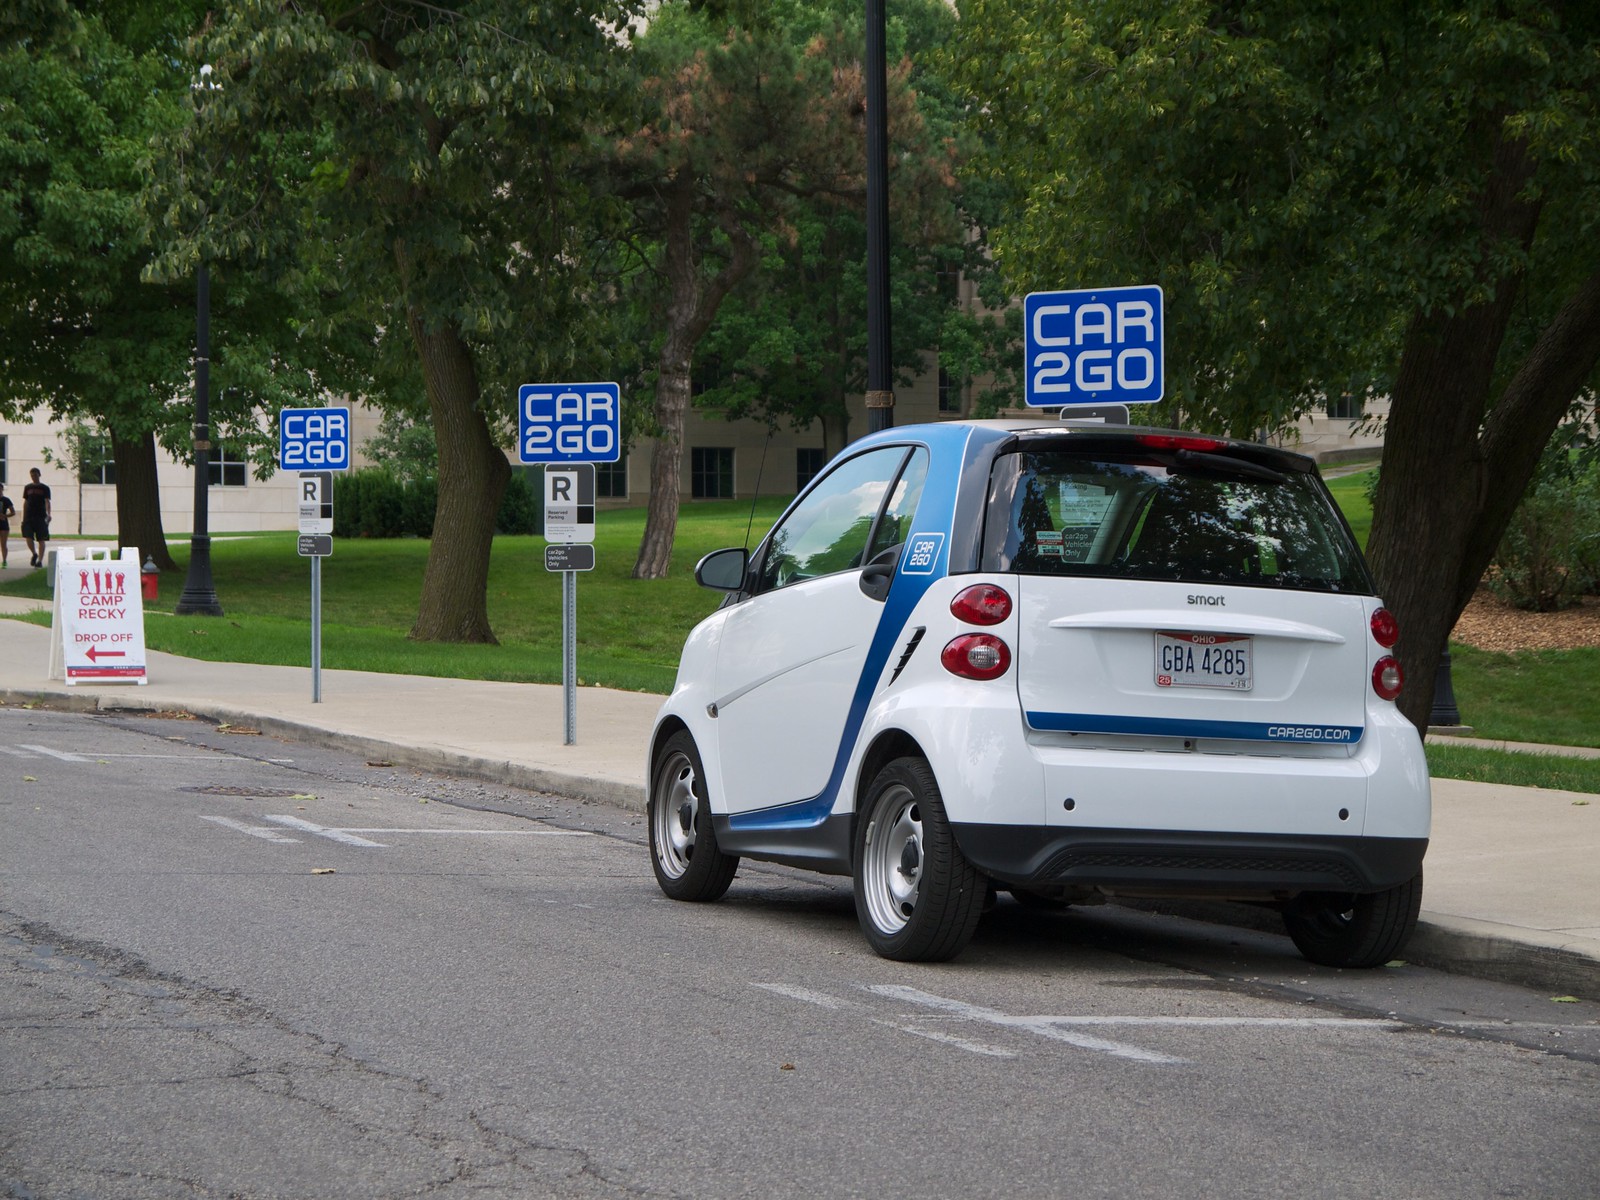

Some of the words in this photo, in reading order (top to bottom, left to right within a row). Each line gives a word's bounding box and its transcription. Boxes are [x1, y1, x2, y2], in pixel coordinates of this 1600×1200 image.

[1033, 300, 1154, 347] CAR
[1033, 348, 1154, 394] 2GO
[525, 392, 614, 422] CAR
[284, 415, 345, 439] CAR
[525, 424, 614, 454] 2GO
[284, 440, 345, 464] 2GO
[303, 481, 317, 501] R
[552, 476, 571, 501] R
[914, 542, 934, 553] CAR
[1065, 549, 1081, 558] Only
[910, 554, 930, 565] 2GO
[80, 595, 123, 606] CAMP
[1187, 594, 1226, 607] smart
[78, 608, 126, 619] RECKY
[75, 633, 107, 642] DROP
[110, 633, 133, 642] OFF
[1192, 635, 1216, 644] OHIO
[1163, 645, 1194, 673] GBA
[1202, 647, 1245, 676] 4285
[1159, 676, 1170, 684] 25
[1268, 726, 1351, 740] CAR2GO.COM
